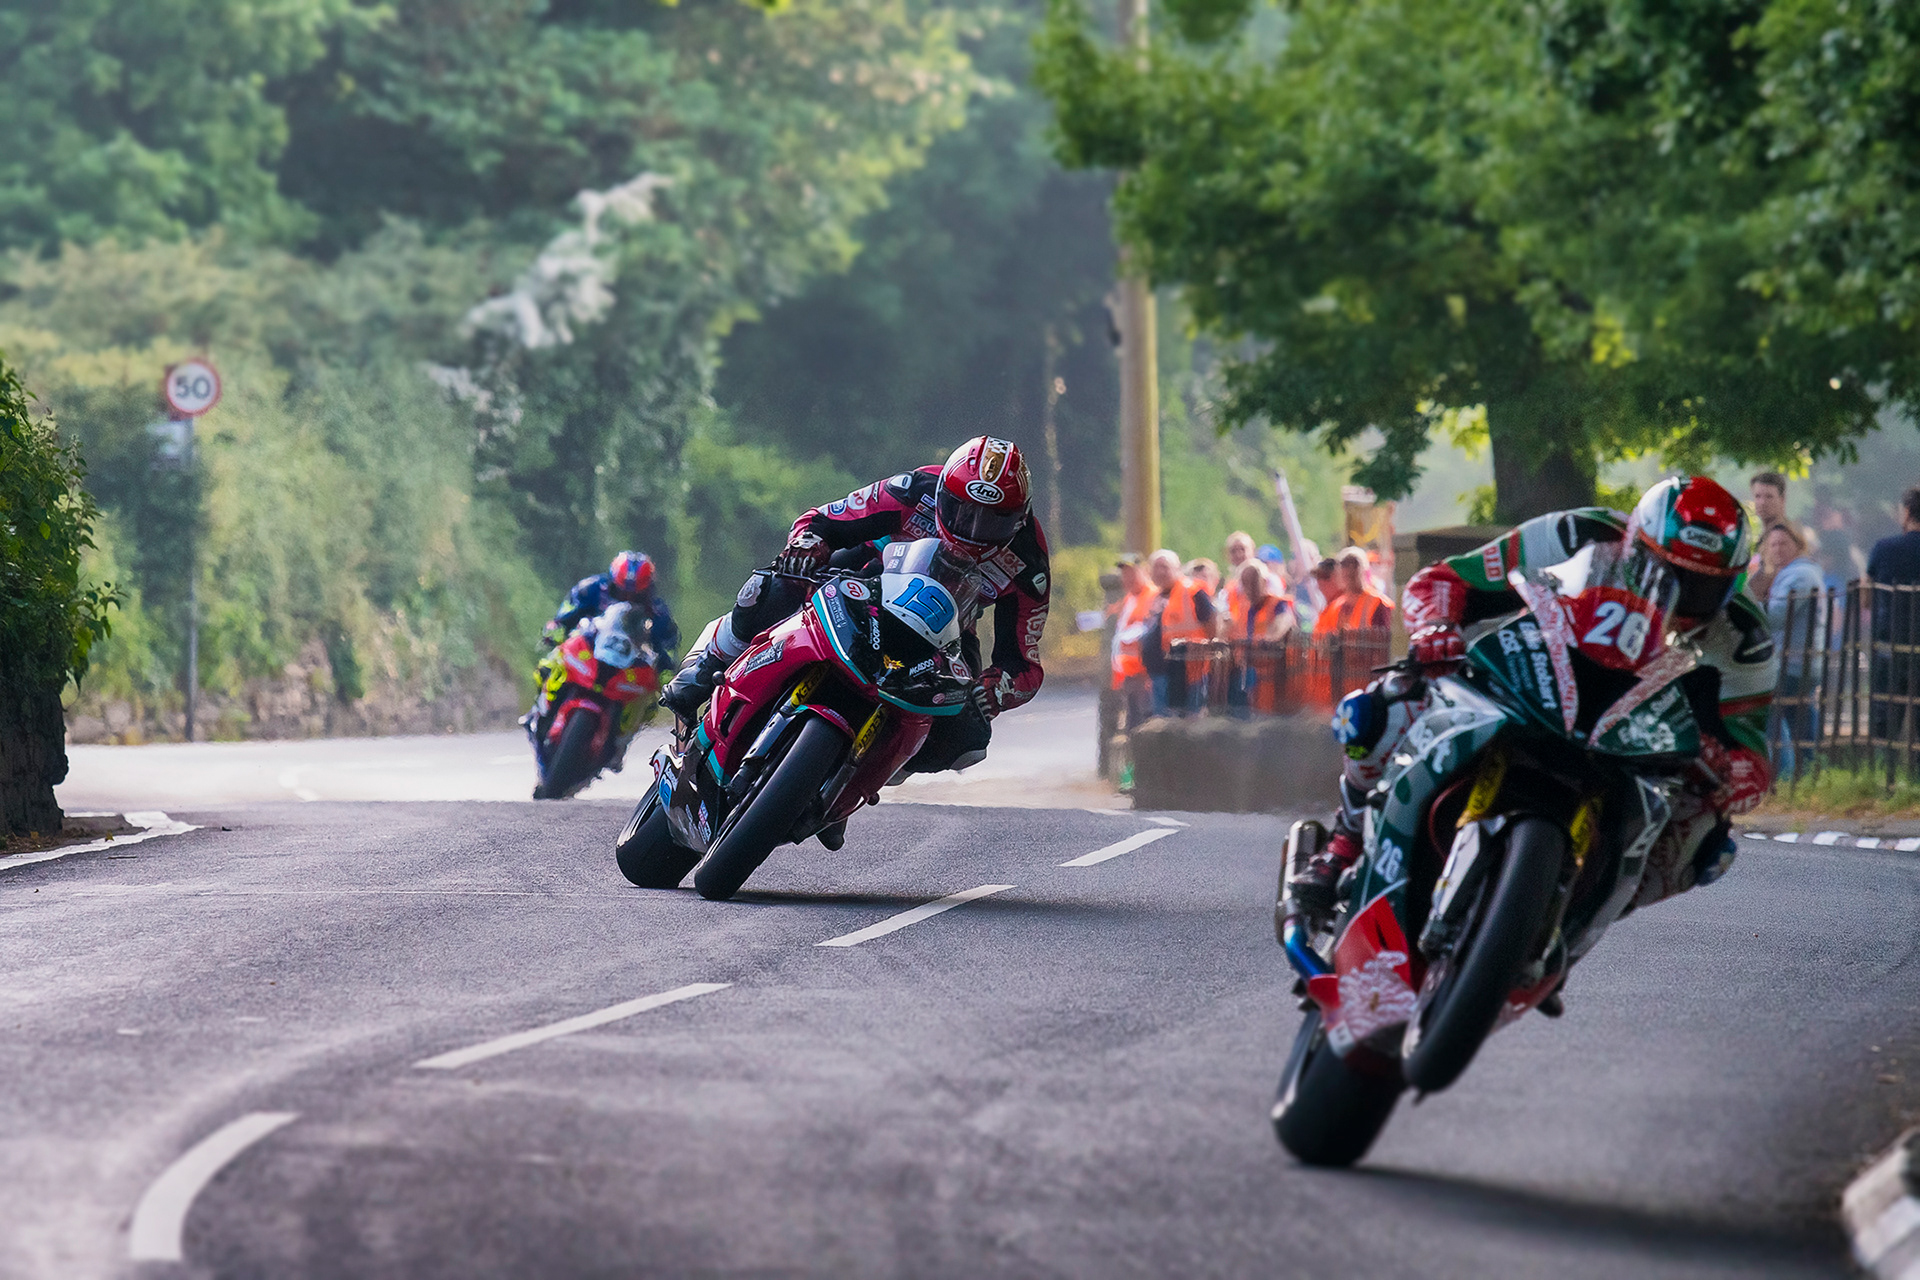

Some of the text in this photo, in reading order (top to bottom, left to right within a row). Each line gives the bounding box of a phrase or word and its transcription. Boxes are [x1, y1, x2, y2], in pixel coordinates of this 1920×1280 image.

[175, 376, 211, 400] 50
[969, 484, 999, 499] Arai
[1583, 601, 1650, 660] 26
[1374, 838, 1403, 883] 26
